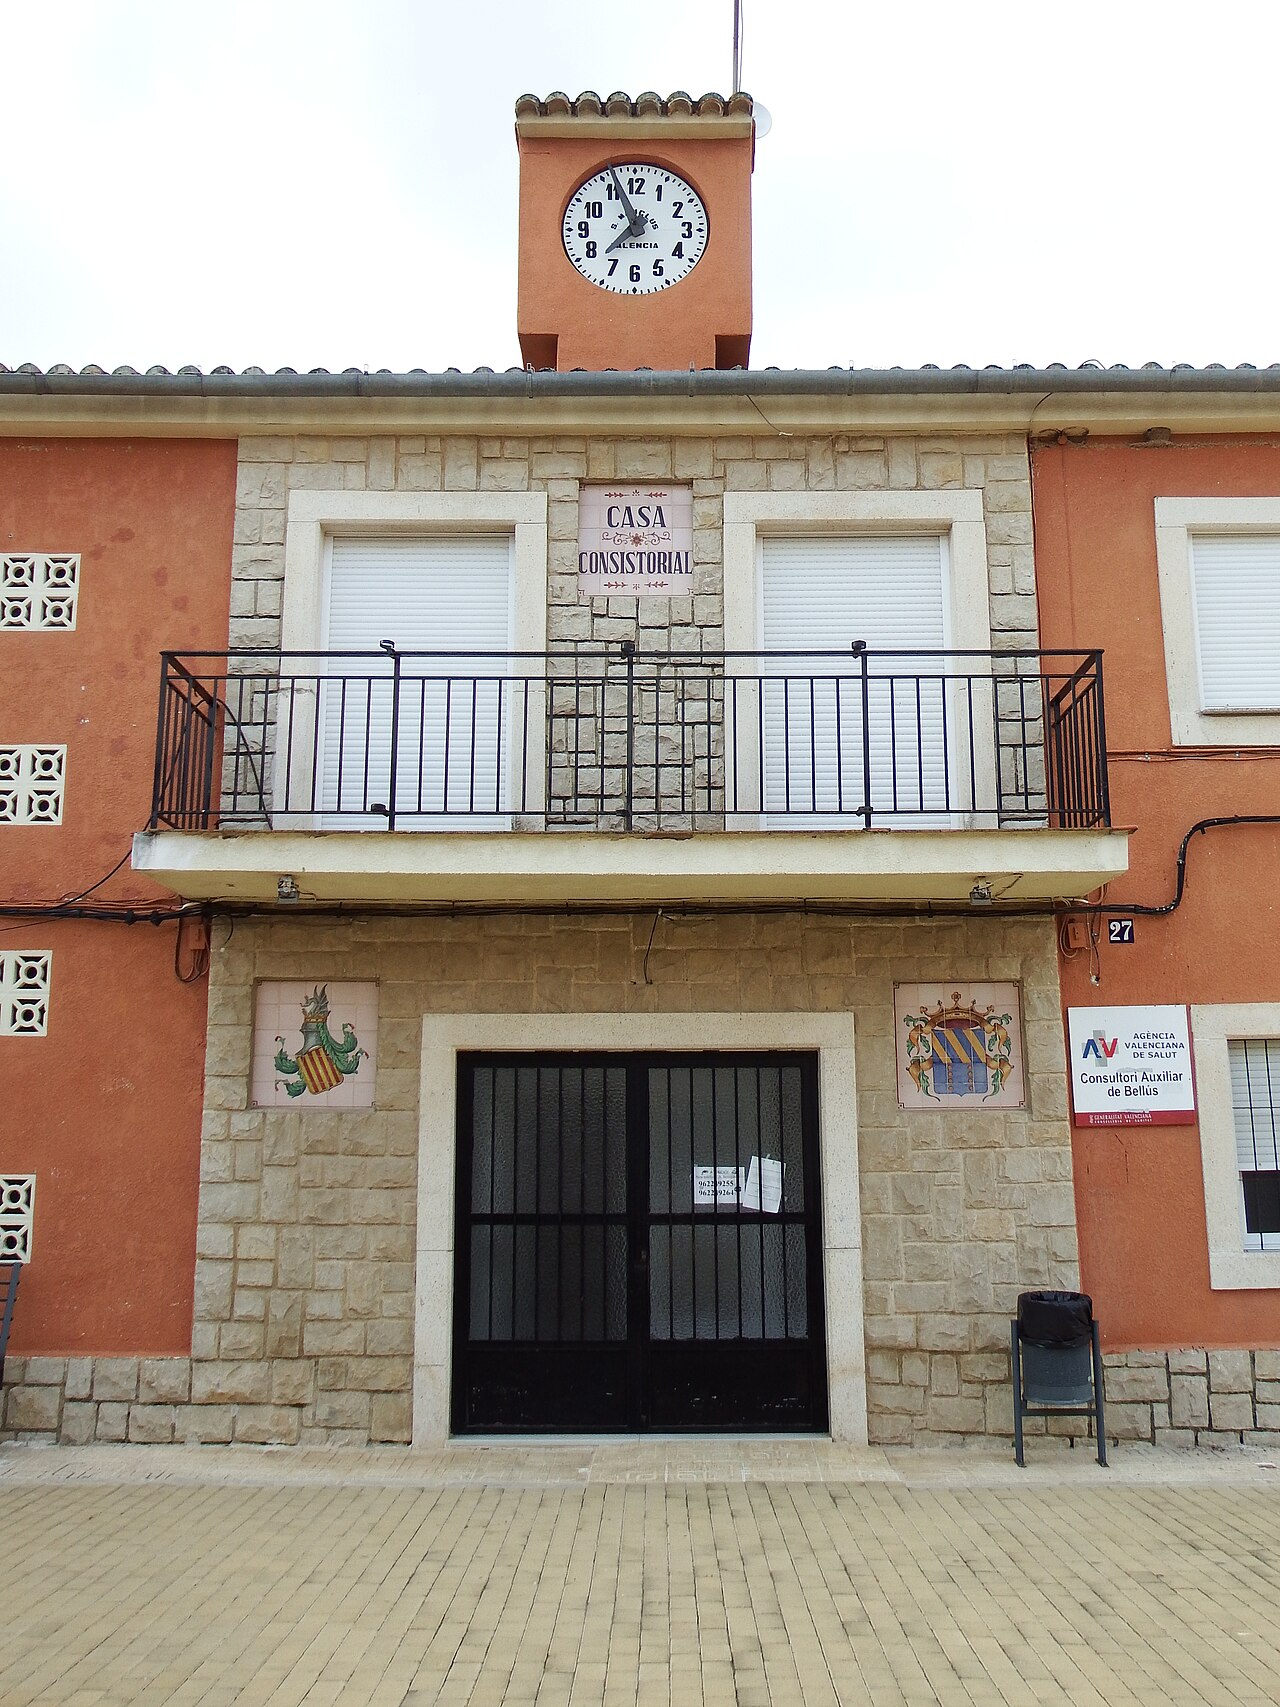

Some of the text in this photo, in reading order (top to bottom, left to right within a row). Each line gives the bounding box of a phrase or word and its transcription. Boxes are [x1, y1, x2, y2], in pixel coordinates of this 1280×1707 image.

[627, 177, 646, 195] 12
[655, 184, 663, 202] 1
[584, 201, 603, 219] 10
[672, 201, 684, 219] 2
[577, 221, 590, 239] 9
[681, 221, 693, 239] 3
[585, 240, 598, 259] 8
[671, 241, 685, 259] 4
[607, 258, 619, 277] 7
[629, 264, 641, 283] 6
[652, 258, 665, 277] 5
[607, 505, 667, 528] CASA
[578, 551, 693, 575] CONSISTORIAL
[1110, 920, 1132, 941] 27
[1133, 1051, 1178, 1059] DE SALUT
[1080, 1070, 1184, 1084] Consultori Auxiliar
[1107, 1084, 1159, 1097] de Bellús
